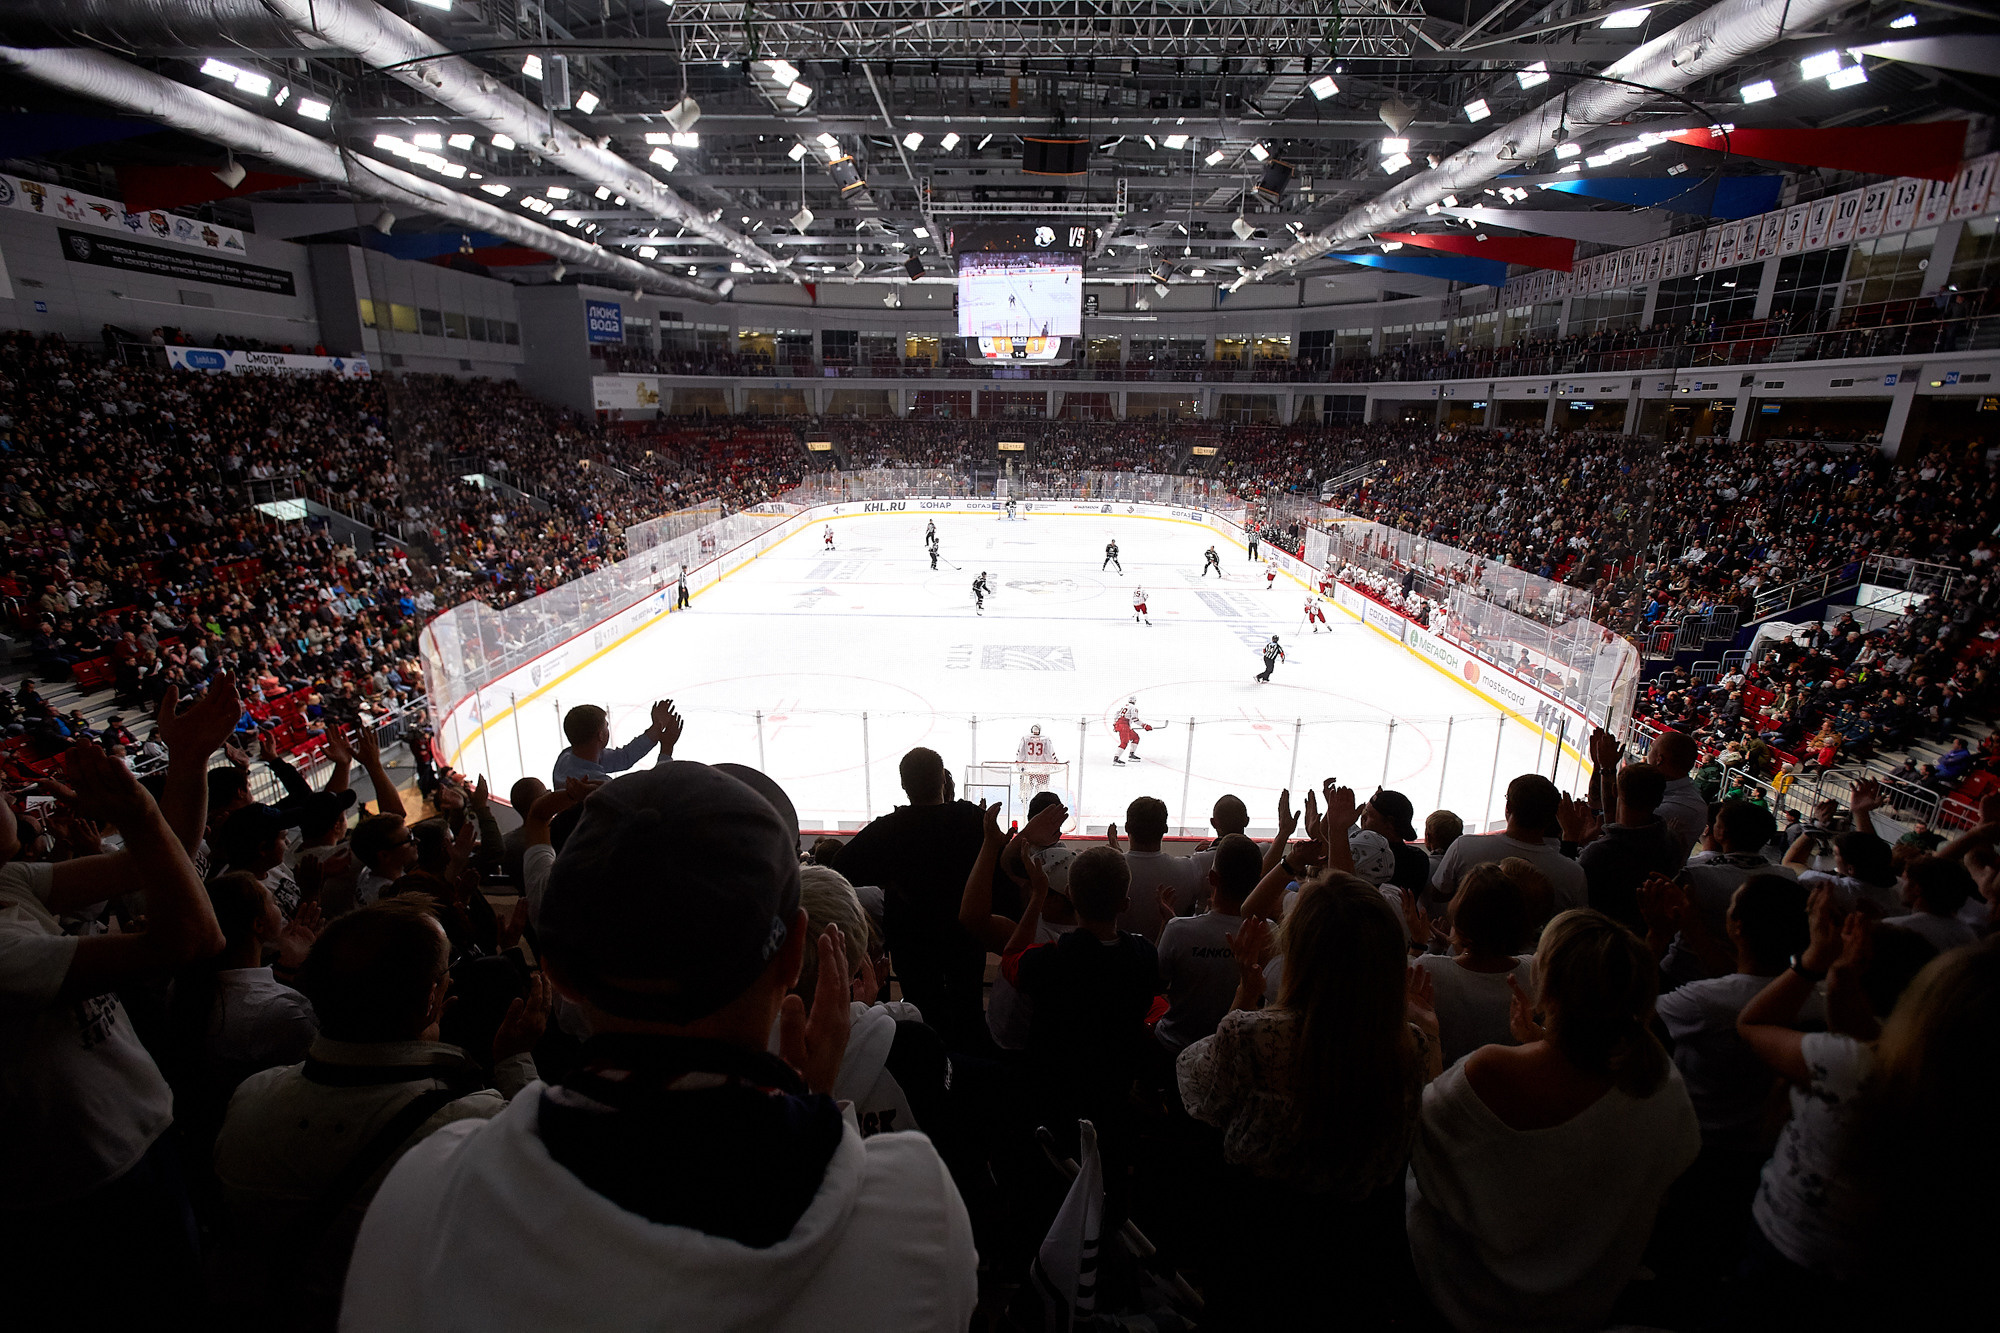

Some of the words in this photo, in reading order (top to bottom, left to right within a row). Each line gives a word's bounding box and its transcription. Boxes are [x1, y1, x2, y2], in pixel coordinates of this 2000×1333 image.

[1864, 192, 1886, 213] 21
[1894, 184, 1918, 206] 13
[1815, 207, 1824, 225] 4
[1837, 199, 1857, 220] 10
[1790, 213, 1800, 231] 5
[1068, 226, 1086, 248] VS
[999, 338, 1006, 351] 1
[1032, 338, 1040, 351] 1
[864, 502, 906, 512] KHL.RU
[1171, 510, 1191, 518] СОГАЗ
[1369, 607, 1389, 625] СОГАЗ
[1418, 636, 1459, 669] МЕГАФОН
[1482, 674, 1526, 706] mastercard
[1534, 699, 1590, 756] KHL.R
[1027, 741, 1044, 756] 33
[1191, 946, 1236, 959] TANKO
